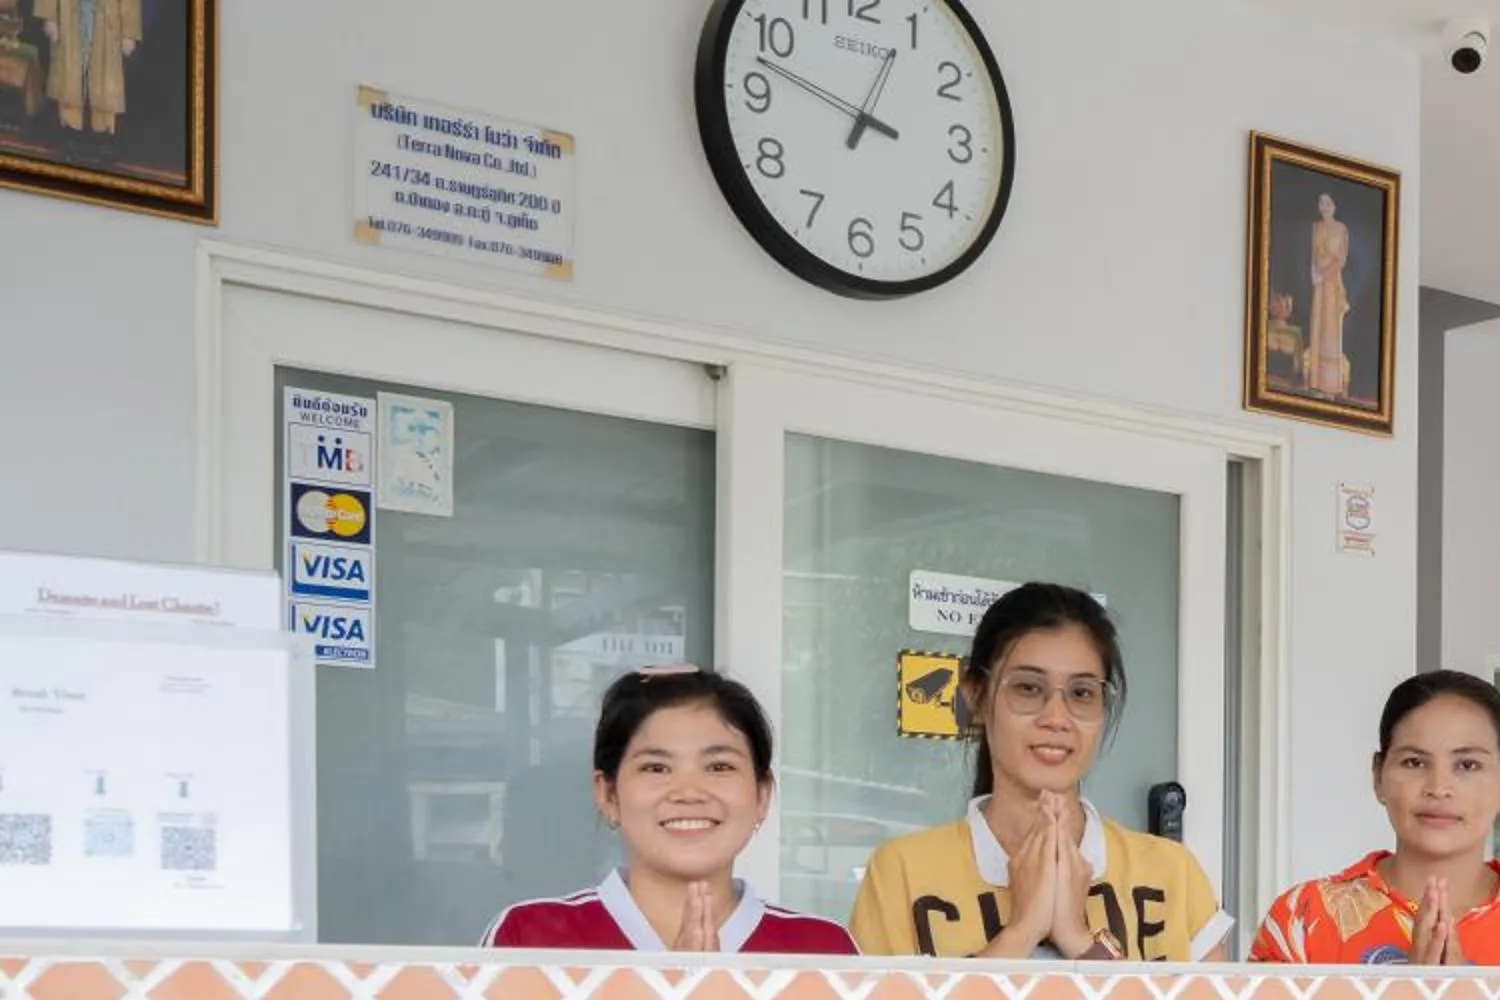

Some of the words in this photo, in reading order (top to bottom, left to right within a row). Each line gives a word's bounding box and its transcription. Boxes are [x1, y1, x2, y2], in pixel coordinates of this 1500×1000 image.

[754, 13, 795, 59] 10
[905, 12, 918, 50] 1
[743, 71, 771, 114] 9
[936, 61, 963, 101] 2
[756, 137, 785, 179] 8
[948, 124, 973, 164] 3
[371, 159, 430, 187] 241/34
[799, 188, 825, 229] 7
[931, 179, 959, 219] 4
[847, 217, 875, 258] 6
[898, 211, 925, 251] 5
[300, 411, 360, 429] WELCOME
[302, 552, 365, 583] VISA
[302, 612, 365, 642] VISA
[937, 609, 961, 623] NO
